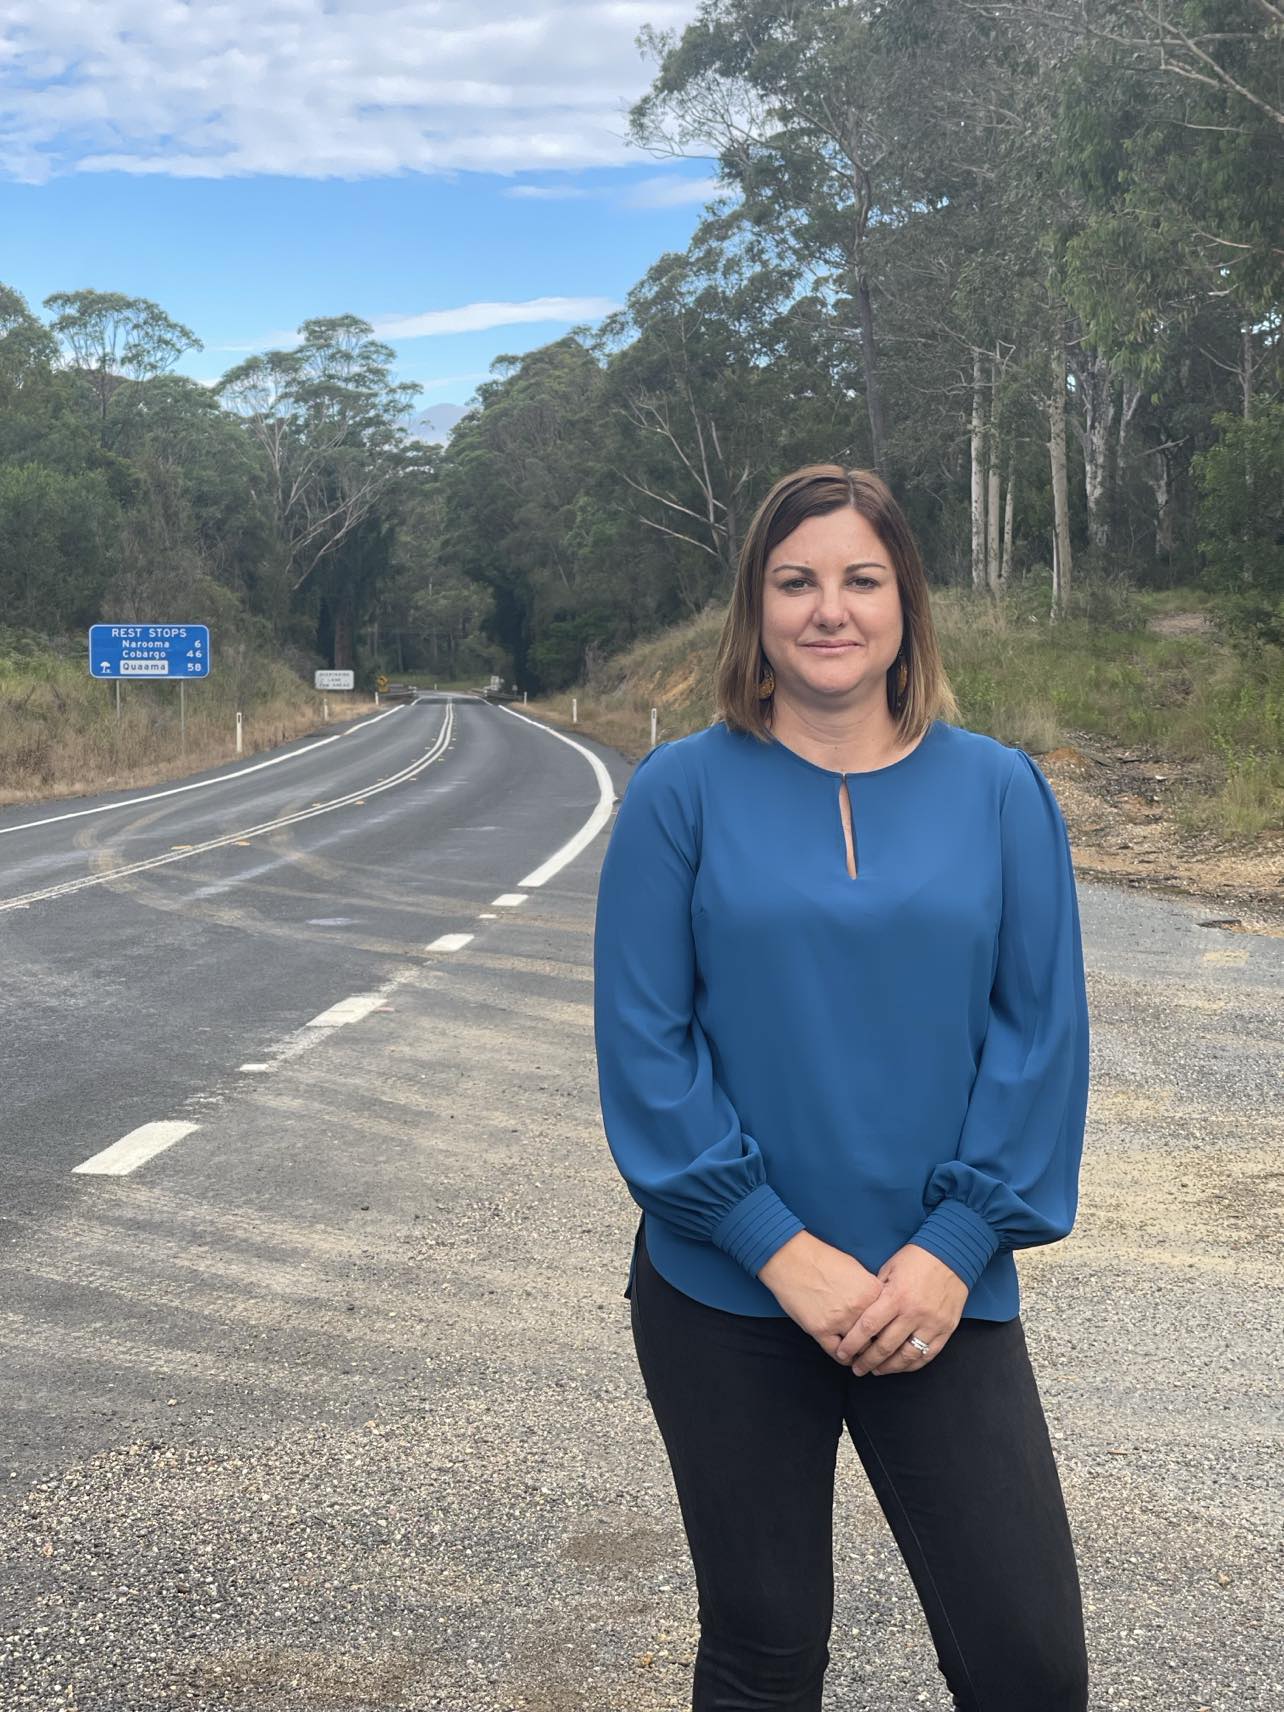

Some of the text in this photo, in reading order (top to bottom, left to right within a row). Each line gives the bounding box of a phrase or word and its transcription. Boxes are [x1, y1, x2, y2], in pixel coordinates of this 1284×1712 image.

[111, 628, 187, 637] REST STOPS
[122, 640, 201, 648] Narooma 6
[122, 650, 202, 660] Cobargo 46
[122, 663, 202, 672] Quaama 58
